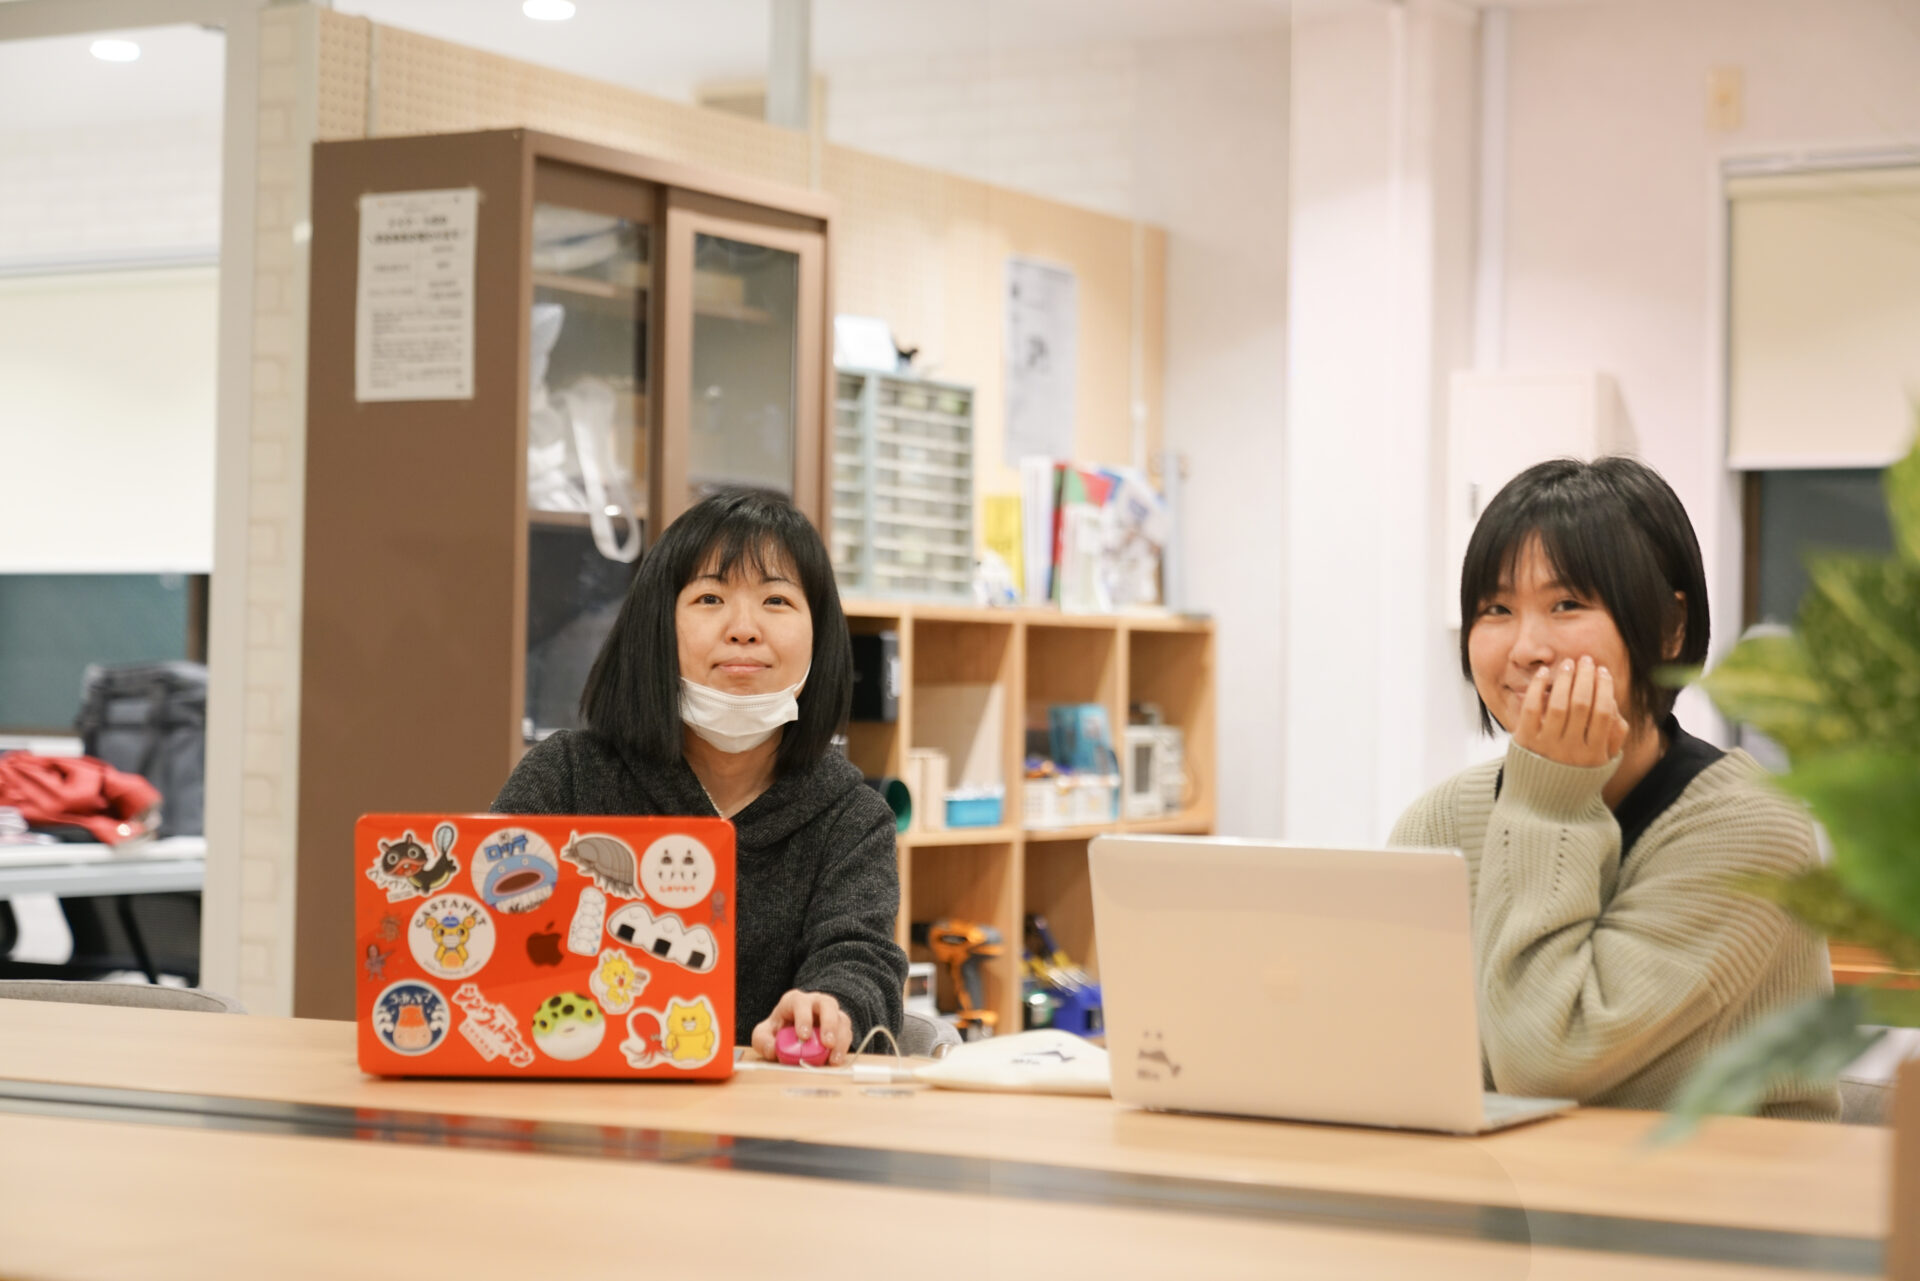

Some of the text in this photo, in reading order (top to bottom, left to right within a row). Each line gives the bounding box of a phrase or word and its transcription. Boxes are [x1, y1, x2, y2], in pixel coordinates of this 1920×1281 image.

[484, 834, 528, 861] ロッテ
[415, 899, 486, 928] CASTANET
